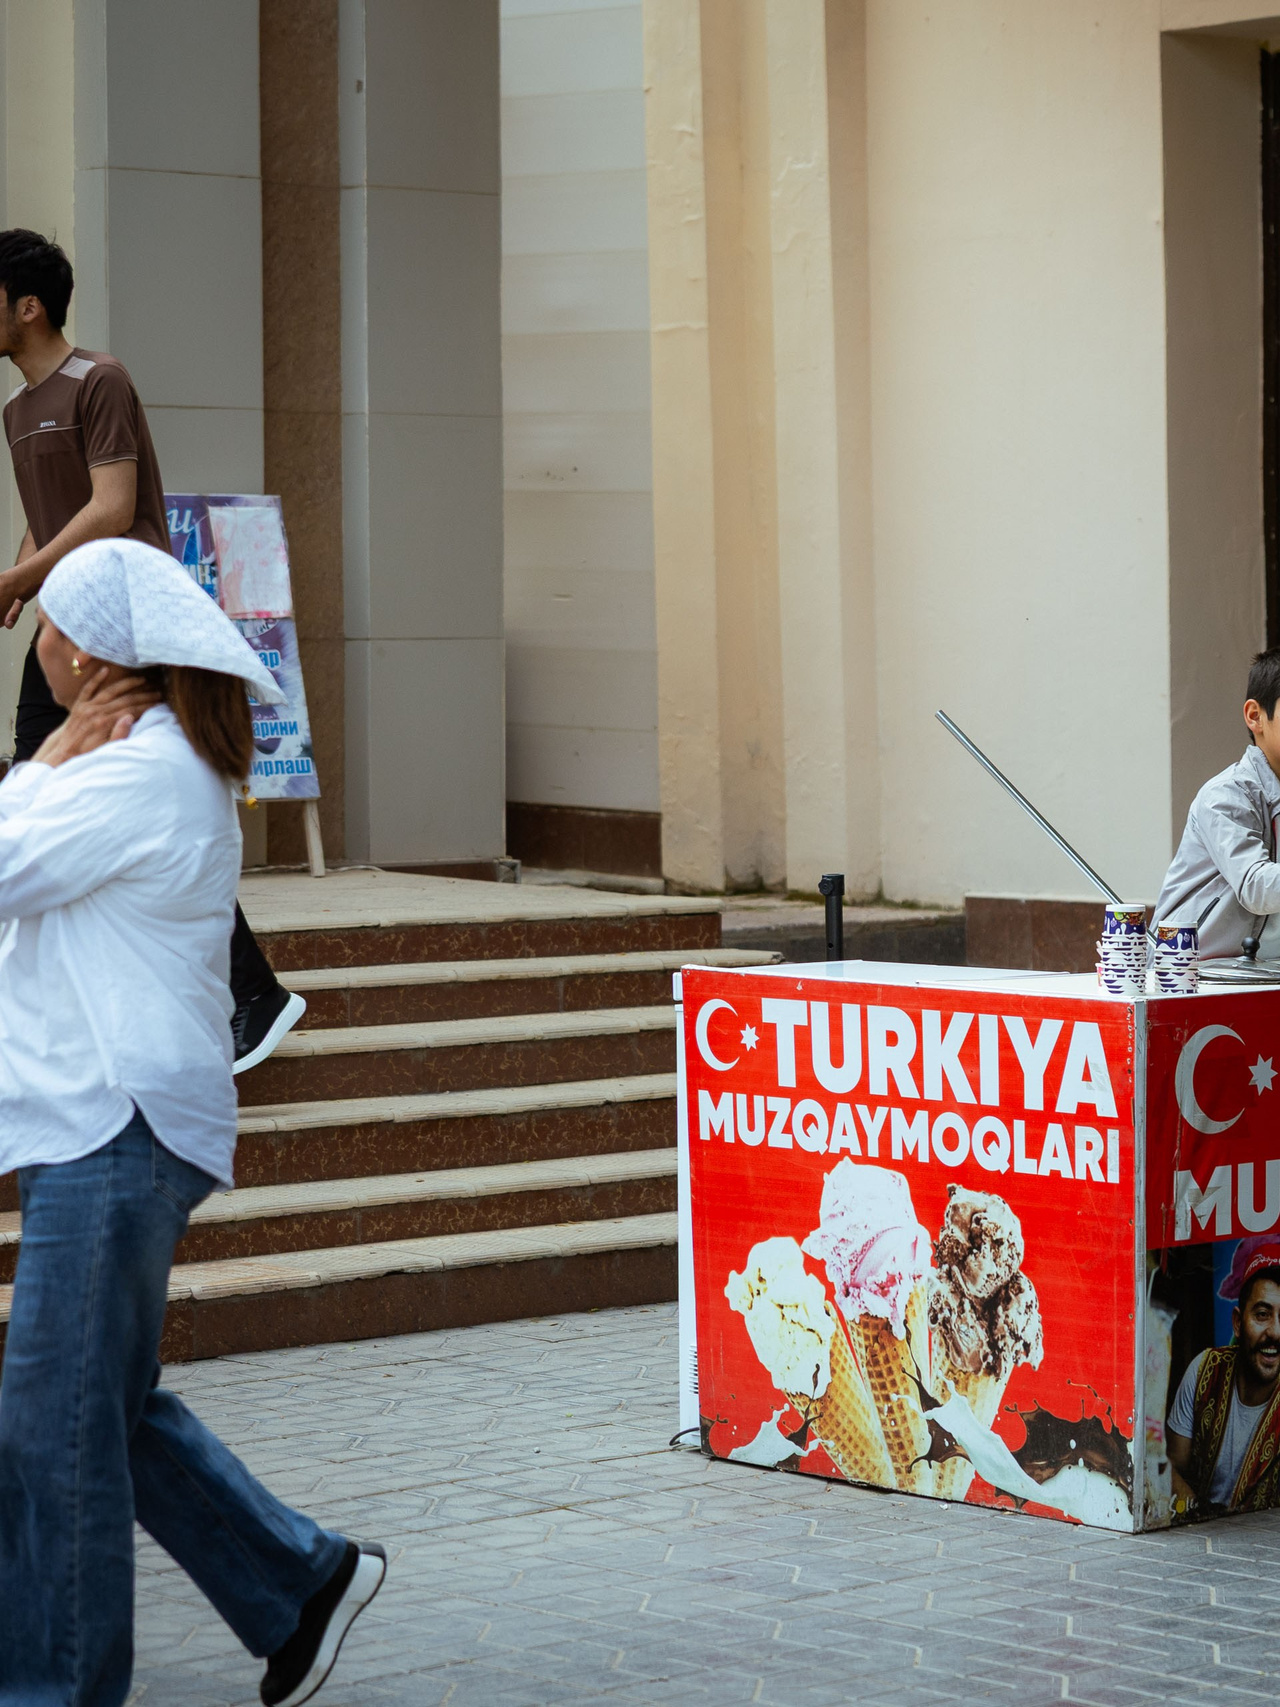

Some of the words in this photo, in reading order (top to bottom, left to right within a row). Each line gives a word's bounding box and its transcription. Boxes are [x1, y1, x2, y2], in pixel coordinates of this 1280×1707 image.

[253, 721, 298, 738] арини
[250, 760, 311, 777] ирлаш
[761, 997, 1118, 1118] TURKIYA
[698, 1089, 1119, 1183] MUZQAYMOQLARI
